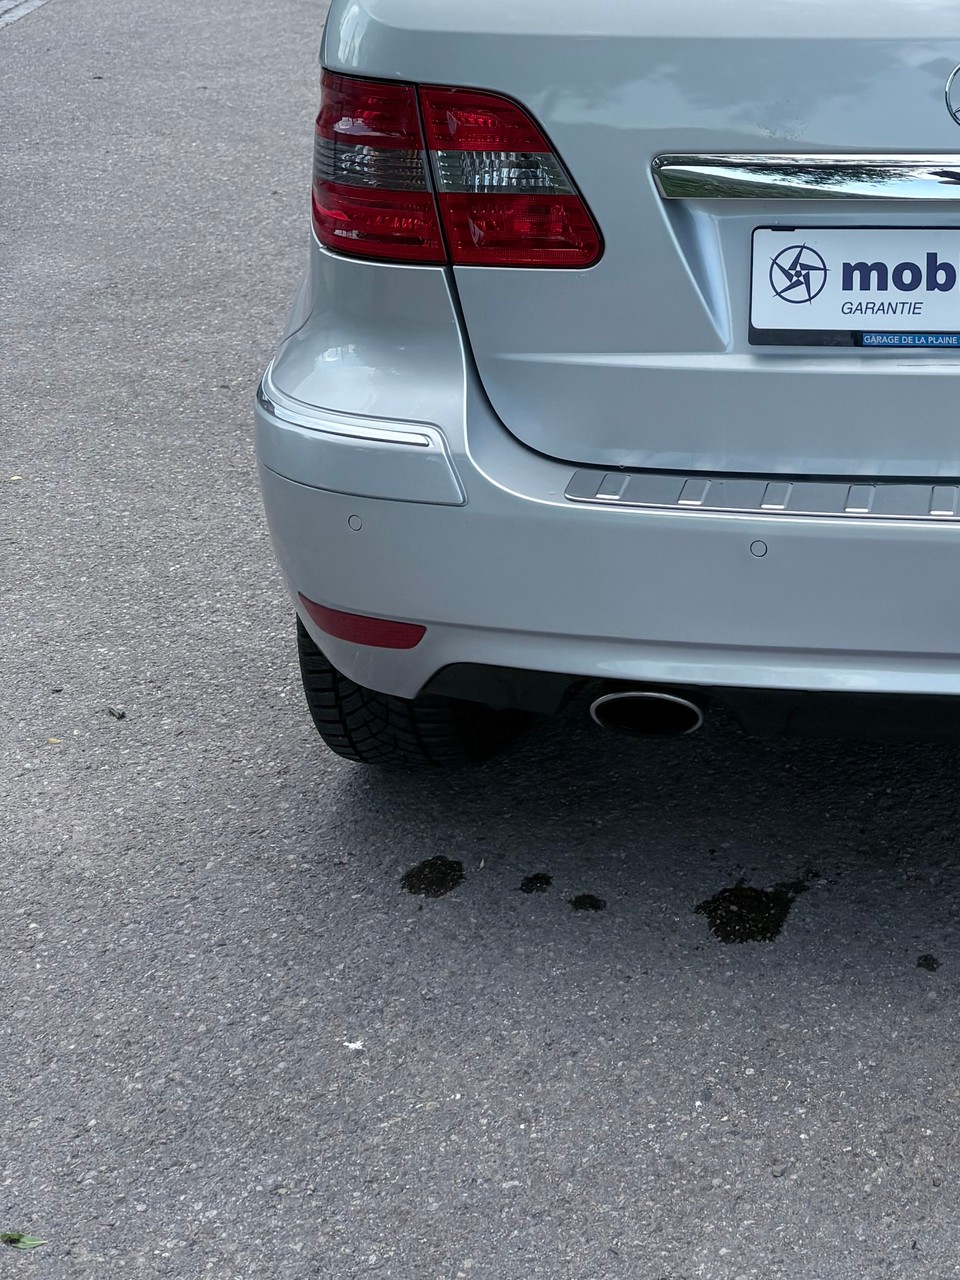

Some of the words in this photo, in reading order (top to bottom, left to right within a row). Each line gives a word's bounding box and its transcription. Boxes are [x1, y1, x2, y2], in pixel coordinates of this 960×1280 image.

[841, 301, 924, 315] GARANTIE
[863, 335, 900, 344] GARAGE
[901, 336, 914, 344] DE
[915, 336, 926, 344] LA
[928, 336, 958, 344] PLAINE
